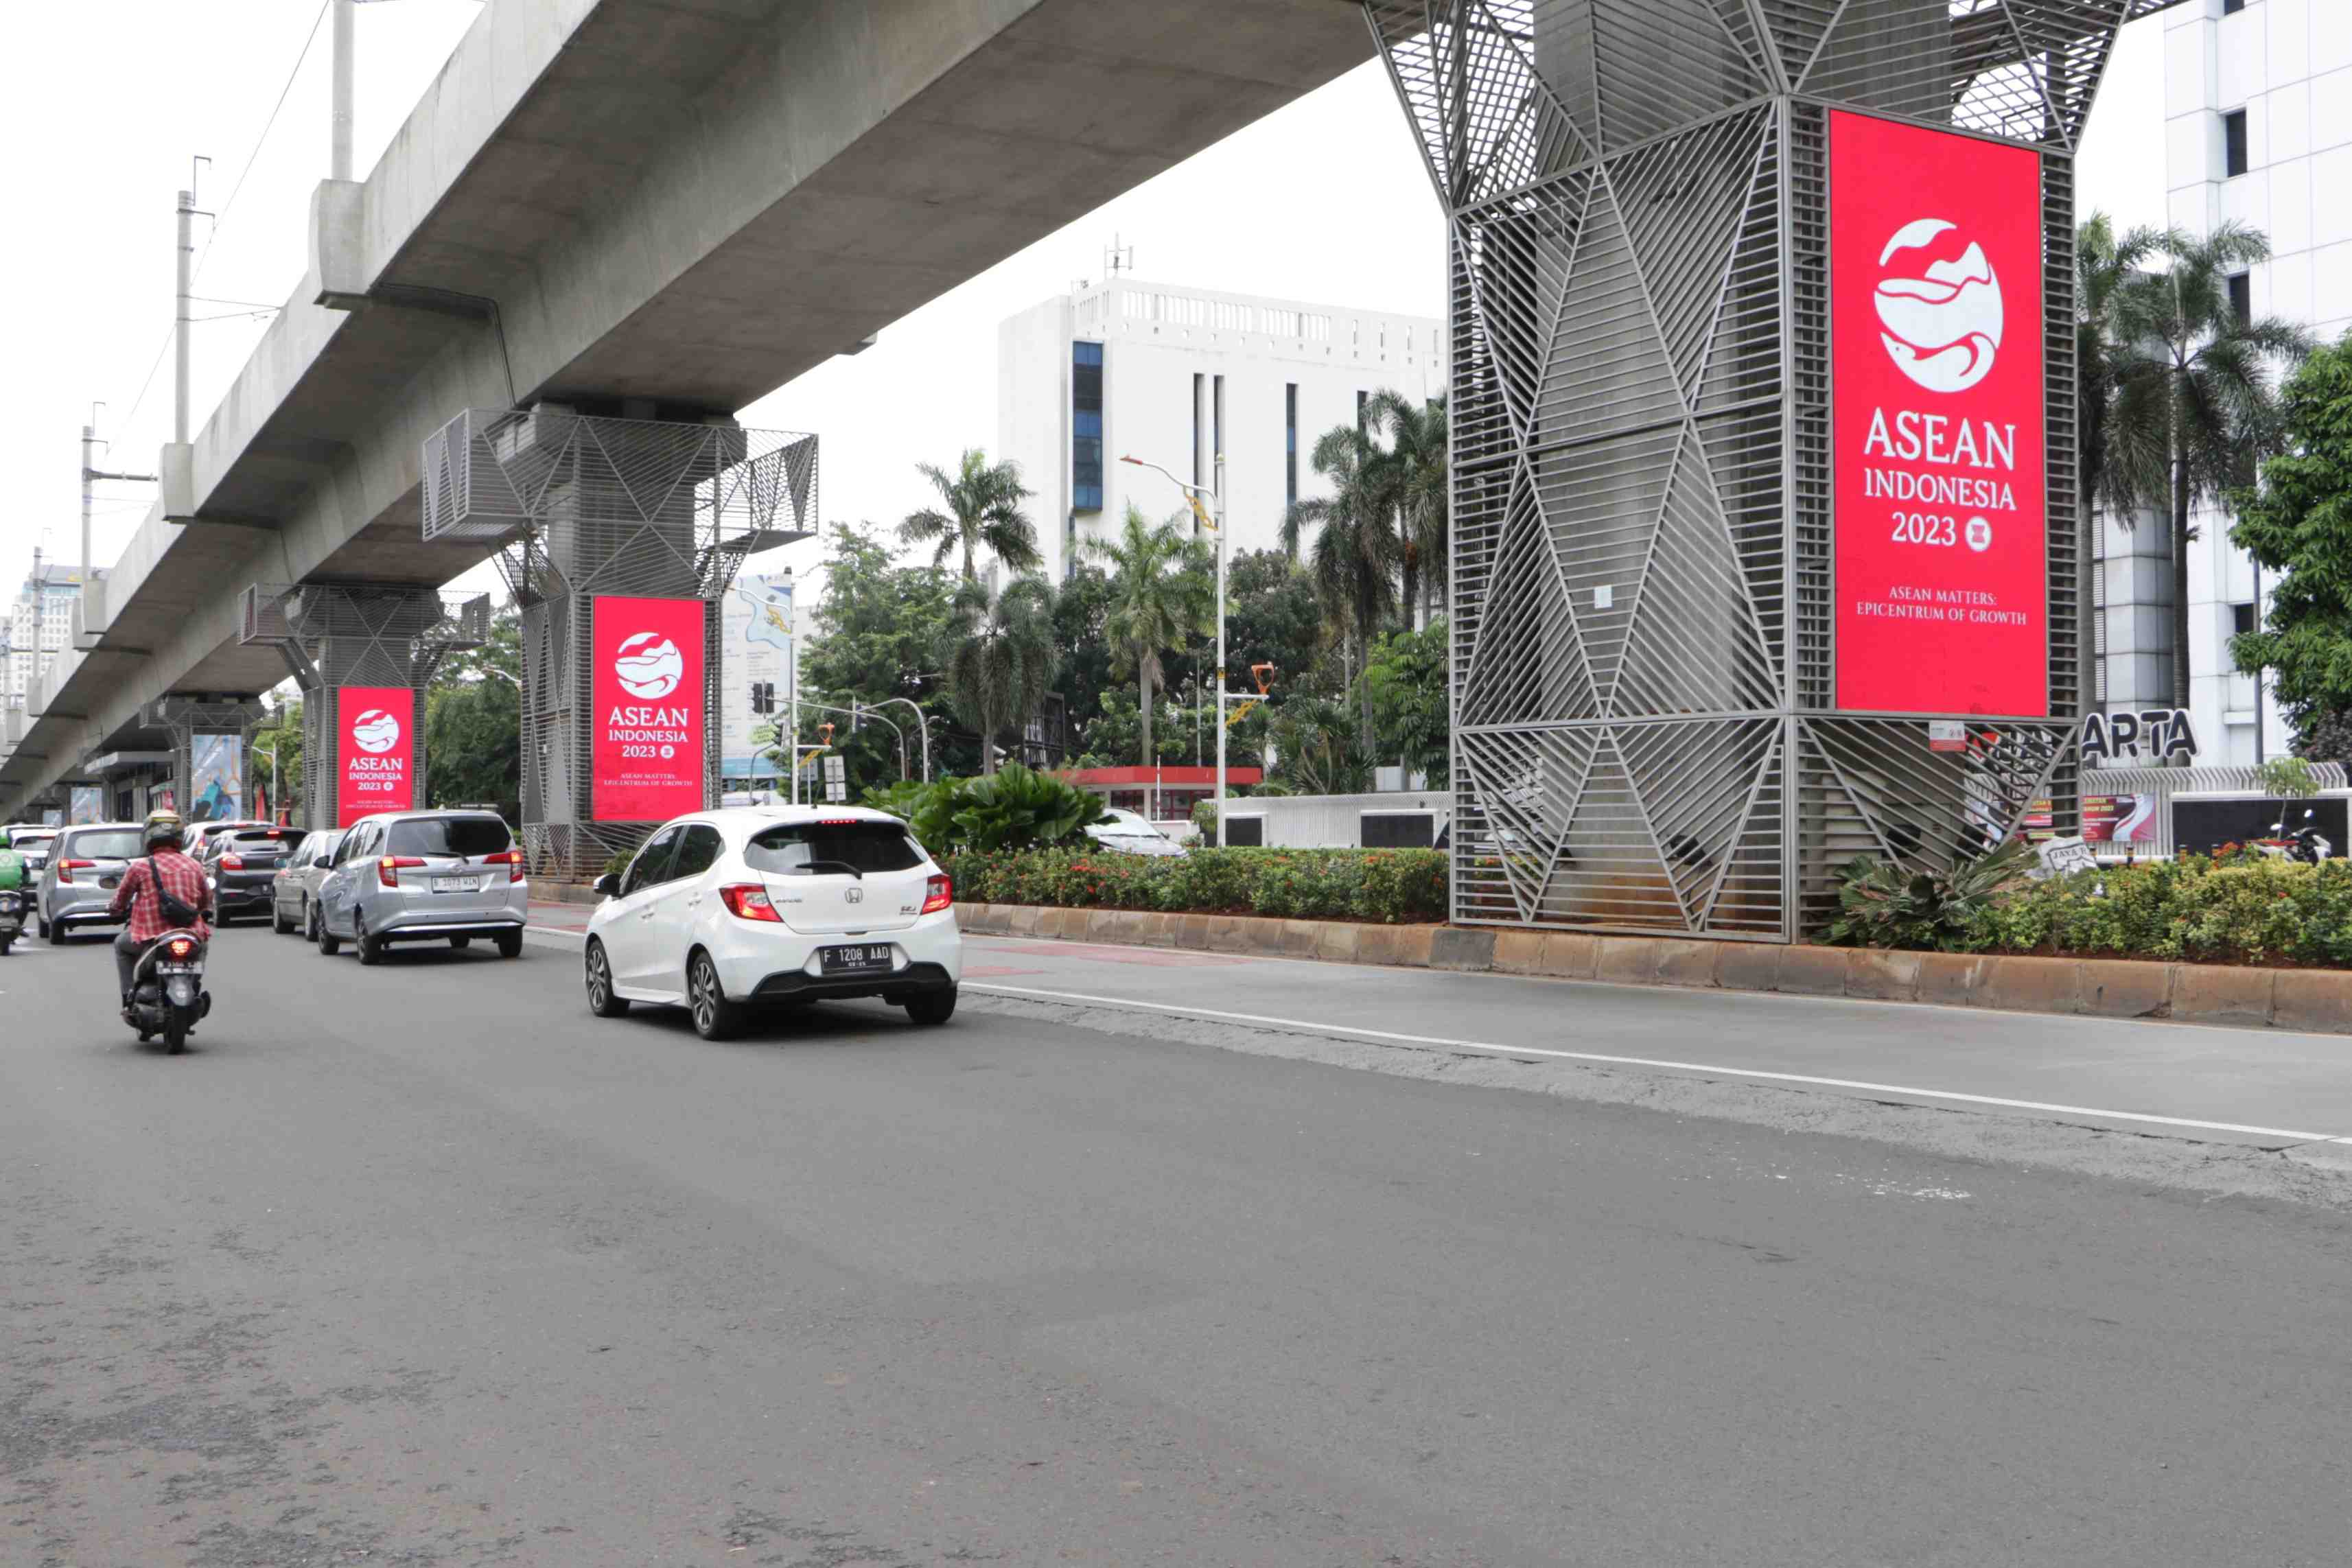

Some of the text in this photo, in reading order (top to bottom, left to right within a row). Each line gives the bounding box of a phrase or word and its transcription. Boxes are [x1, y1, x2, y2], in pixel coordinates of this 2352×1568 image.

[1863, 406, 2016, 471] ASEAN
[1863, 467, 2017, 511] INDONESIA
[1891, 512, 1957, 546] 2023
[1889, 586, 1998, 606] ASEAN MATTERS:
[1856, 601, 2027, 625] EPICENTRUM OF GROWTH
[609, 706, 688, 727] ASEAN
[608, 729, 688, 742] INDONESIA
[622, 745, 656, 758] 2023
[349, 758, 403, 771] ASEAN
[349, 772, 402, 780] INDONESIA
[357, 782, 381, 791] 2023
[824, 950, 831, 962] F
[839, 948, 863, 962] 1208
